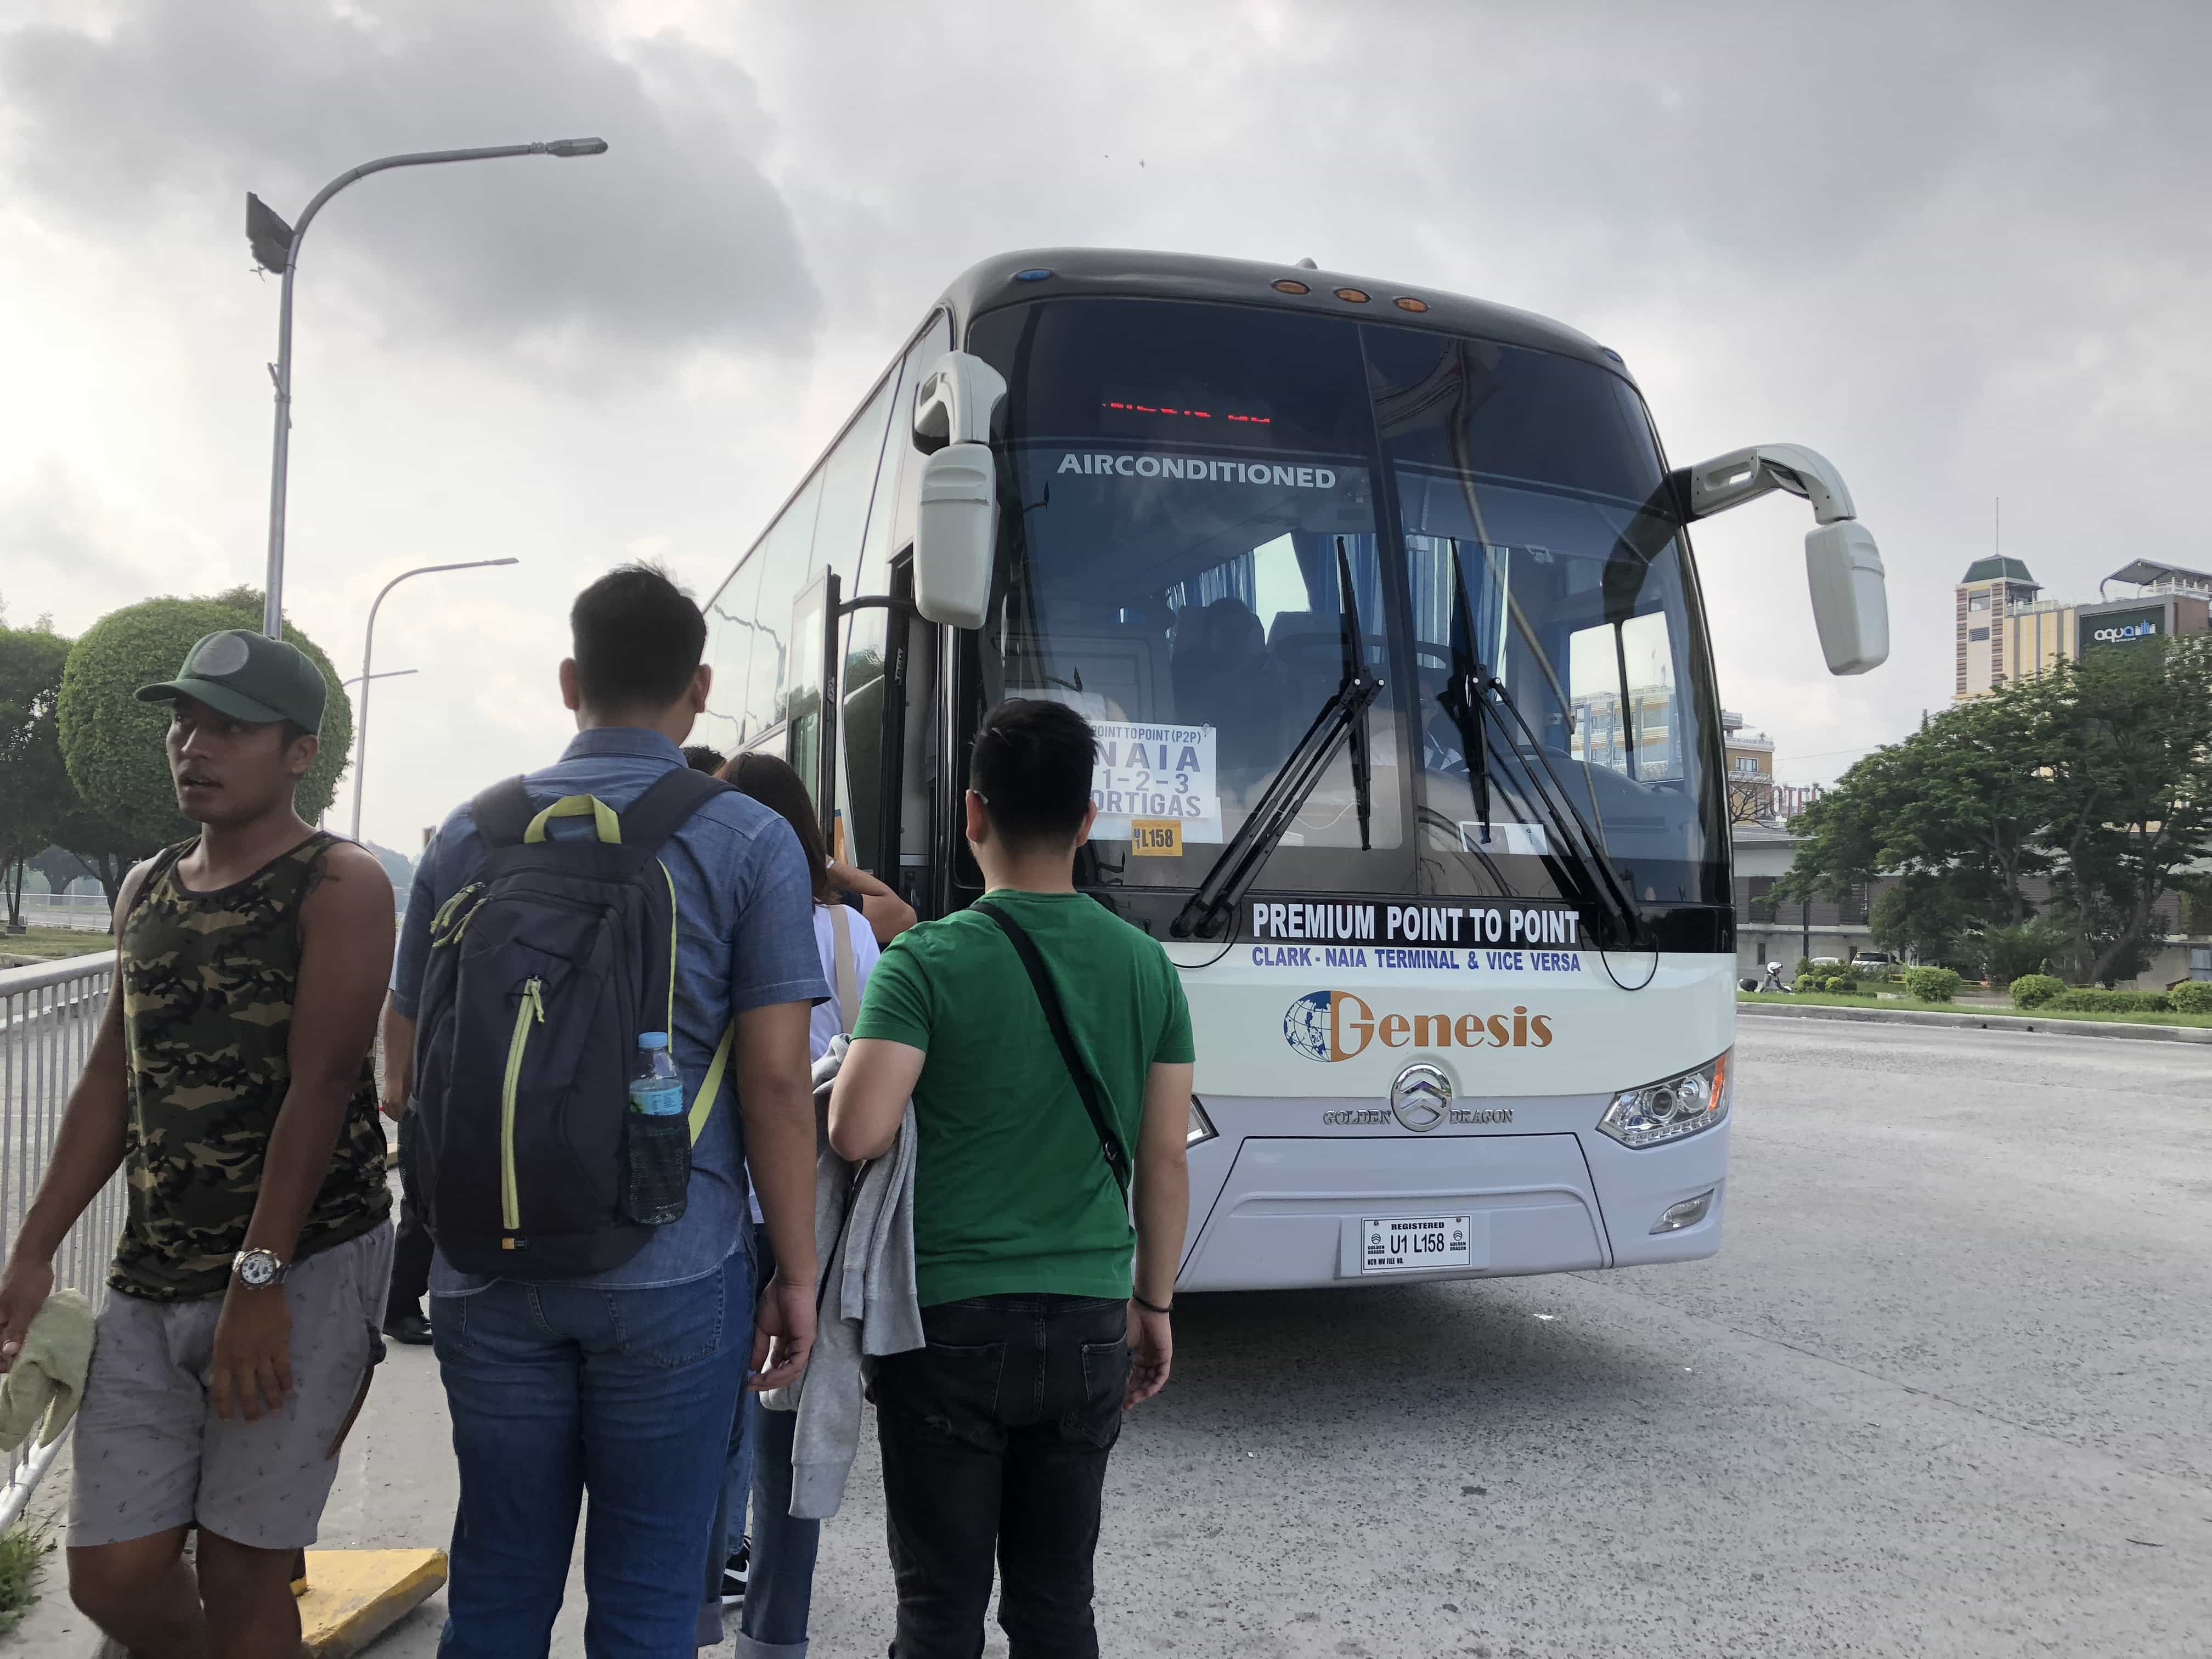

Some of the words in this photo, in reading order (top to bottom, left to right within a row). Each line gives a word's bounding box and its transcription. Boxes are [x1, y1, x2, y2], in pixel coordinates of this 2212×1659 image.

[1057, 453, 1336, 489] AIRCONDITIONED
[2094, 625, 2135, 643] aqua
[1124, 727, 1137, 738] TO
[1138, 729, 1170, 741] POINT
[1172, 730, 1201, 744] (P2P)
[1093, 741, 1200, 772] NAIA
[1091, 789, 1201, 817] ORTIGAS
[1142, 828, 1173, 848] L158
[1252, 902, 1375, 940] PREMIUM
[1387, 905, 1464, 942] POINT
[1465, 908, 1502, 943] TO
[1510, 909, 1580, 944] POINT
[1325, 948, 1367, 967] NAIA
[1374, 949, 1459, 969] TERMINAL
[1467, 951, 1479, 969] &
[1486, 952, 1523, 970] VICE
[1531, 952, 1581, 972] VERSA
[1330, 990, 1553, 1063] Genesis
[1323, 1109, 1392, 1125] GOLDEN
[1448, 1108, 1515, 1124] DRAGON
[1391, 1222, 1444, 1231] REGISTERED
[1391, 1234, 1407, 1254] U1
[1414, 1233, 1444, 1253] L158
